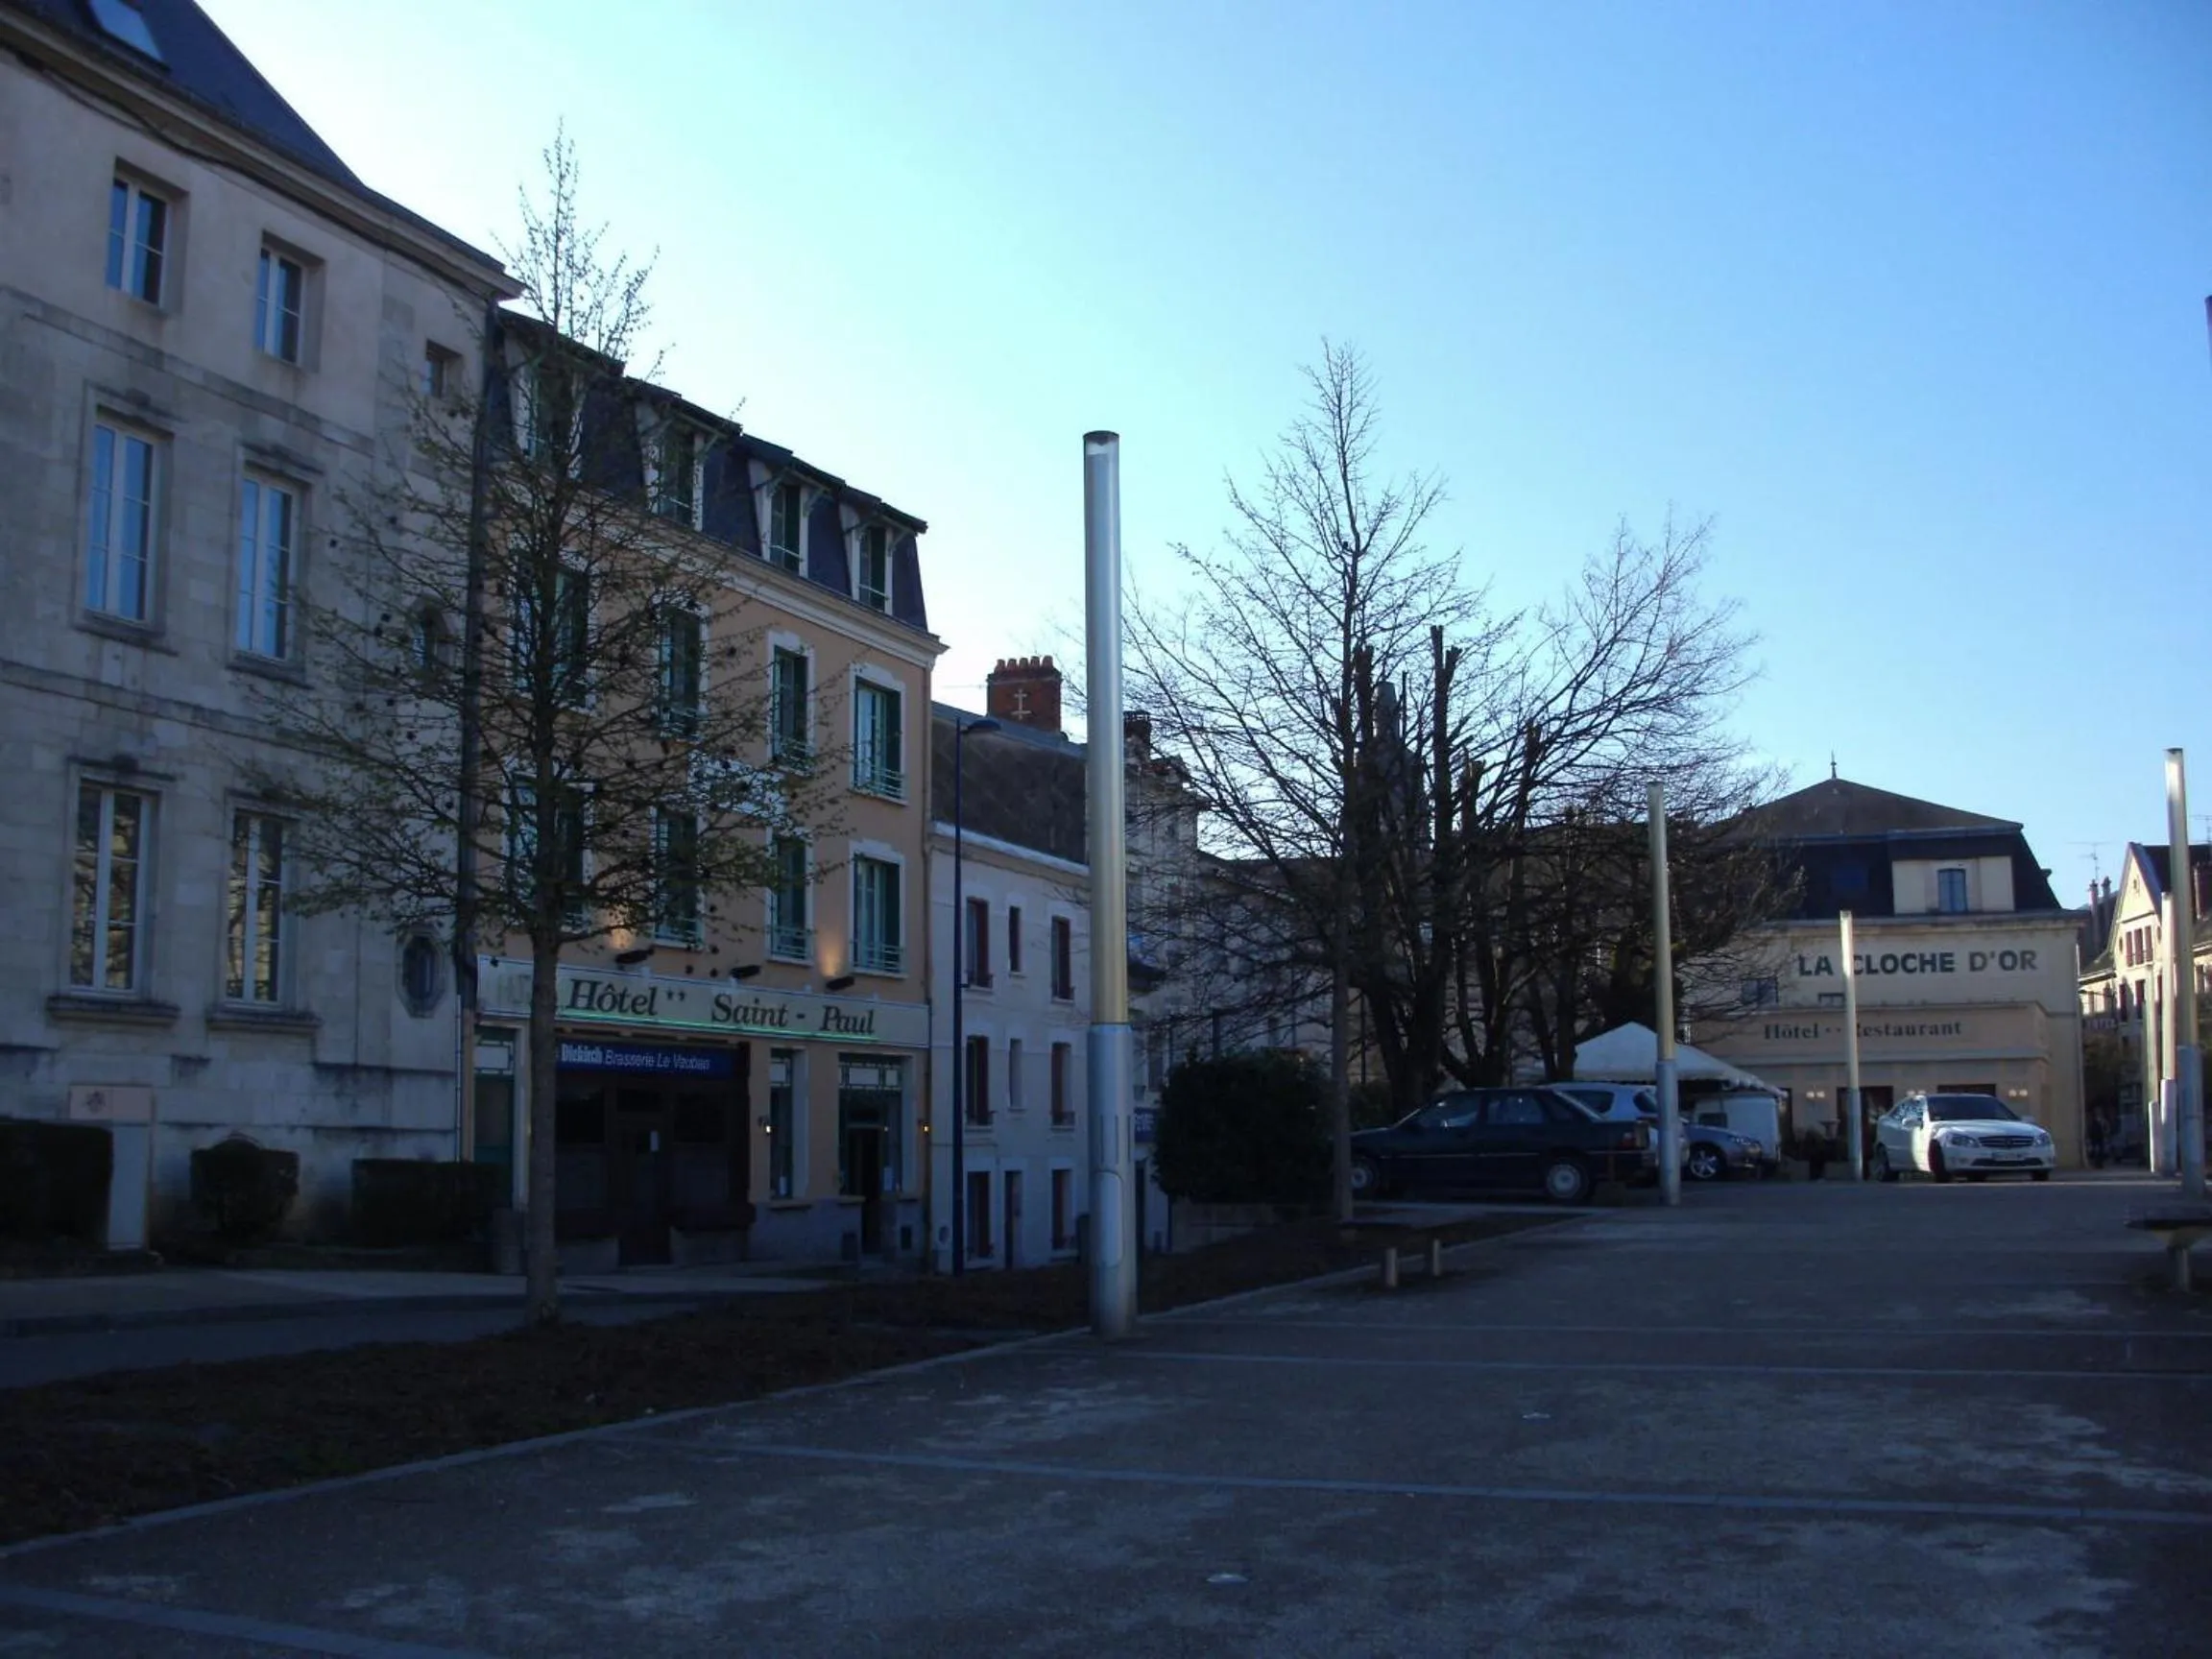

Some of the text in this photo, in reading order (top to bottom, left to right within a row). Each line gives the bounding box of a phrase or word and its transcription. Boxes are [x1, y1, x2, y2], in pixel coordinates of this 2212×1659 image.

[1798, 950, 2037, 976] LA CLOCHE D'OR
[567, 979, 658, 1016] Hôtel
[711, 993, 788, 1027] Saint
[820, 1003, 874, 1035] Paul
[1765, 1022, 1818, 1040] Hôtel
